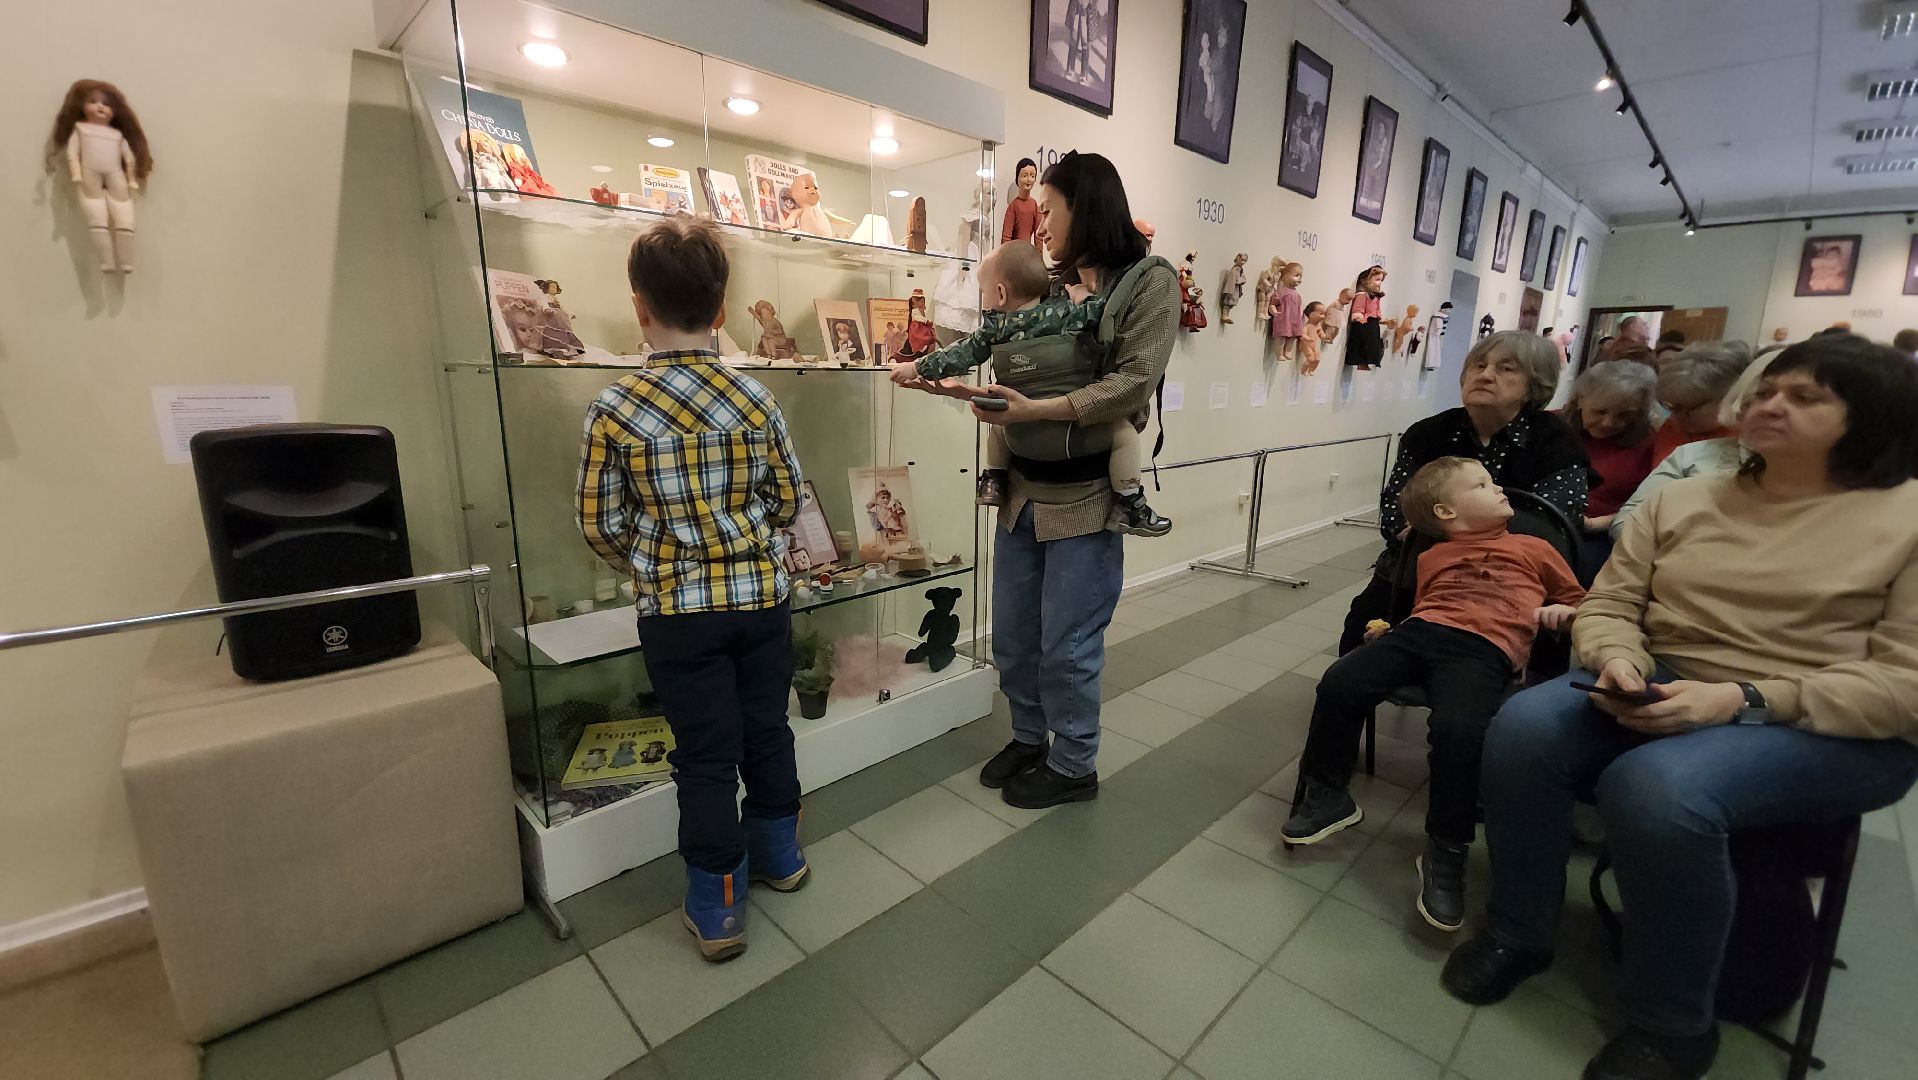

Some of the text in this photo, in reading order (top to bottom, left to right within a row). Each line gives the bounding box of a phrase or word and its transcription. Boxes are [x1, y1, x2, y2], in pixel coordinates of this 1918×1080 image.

[441, 109, 521, 141] CHINA DOLLS
[1197, 197, 1224, 224] 1930
[1298, 230, 1317, 252] 1940
